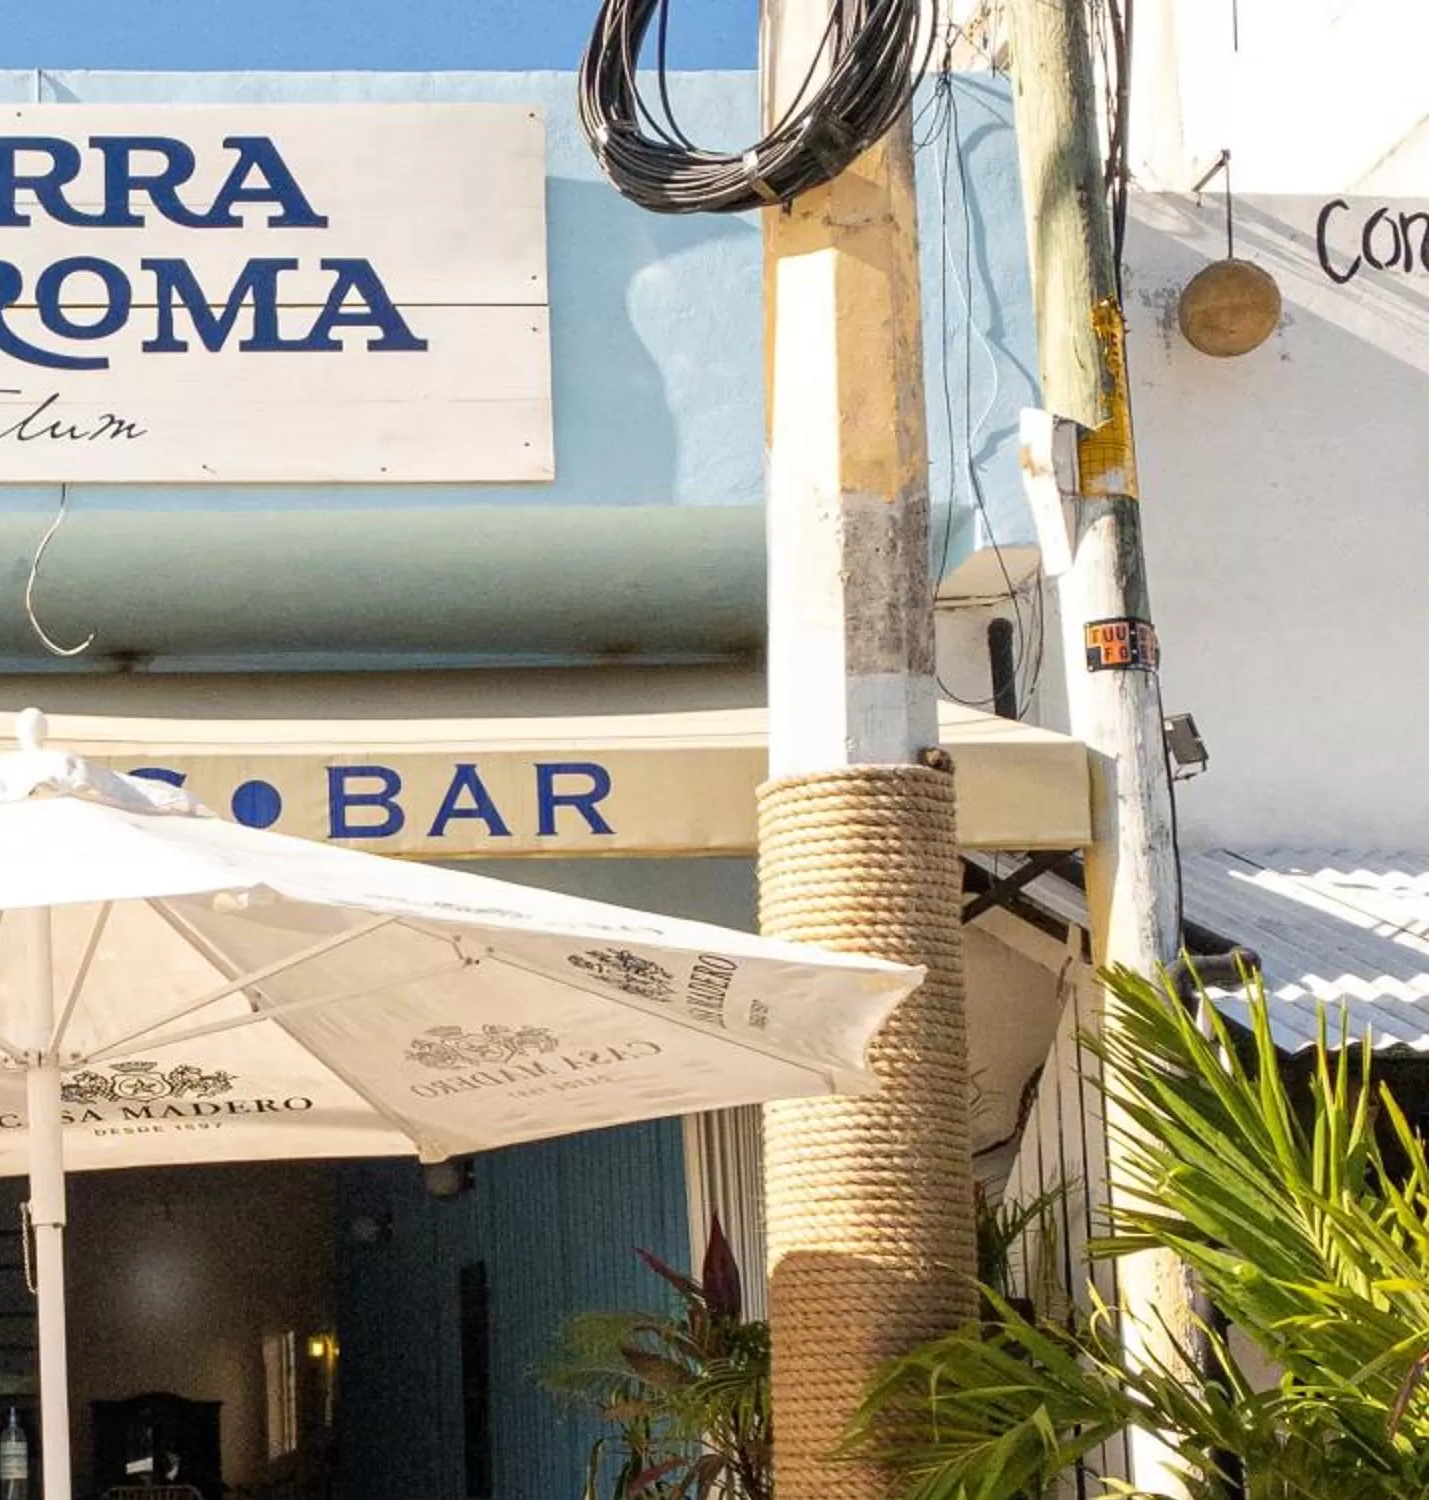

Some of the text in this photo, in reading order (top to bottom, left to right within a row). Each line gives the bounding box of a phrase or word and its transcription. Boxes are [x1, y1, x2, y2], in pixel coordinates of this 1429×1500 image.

[327, 763, 616, 838] BAR
[121, 1096, 314, 1119] MADERO
[93, 1124, 165, 1137] DESDE
